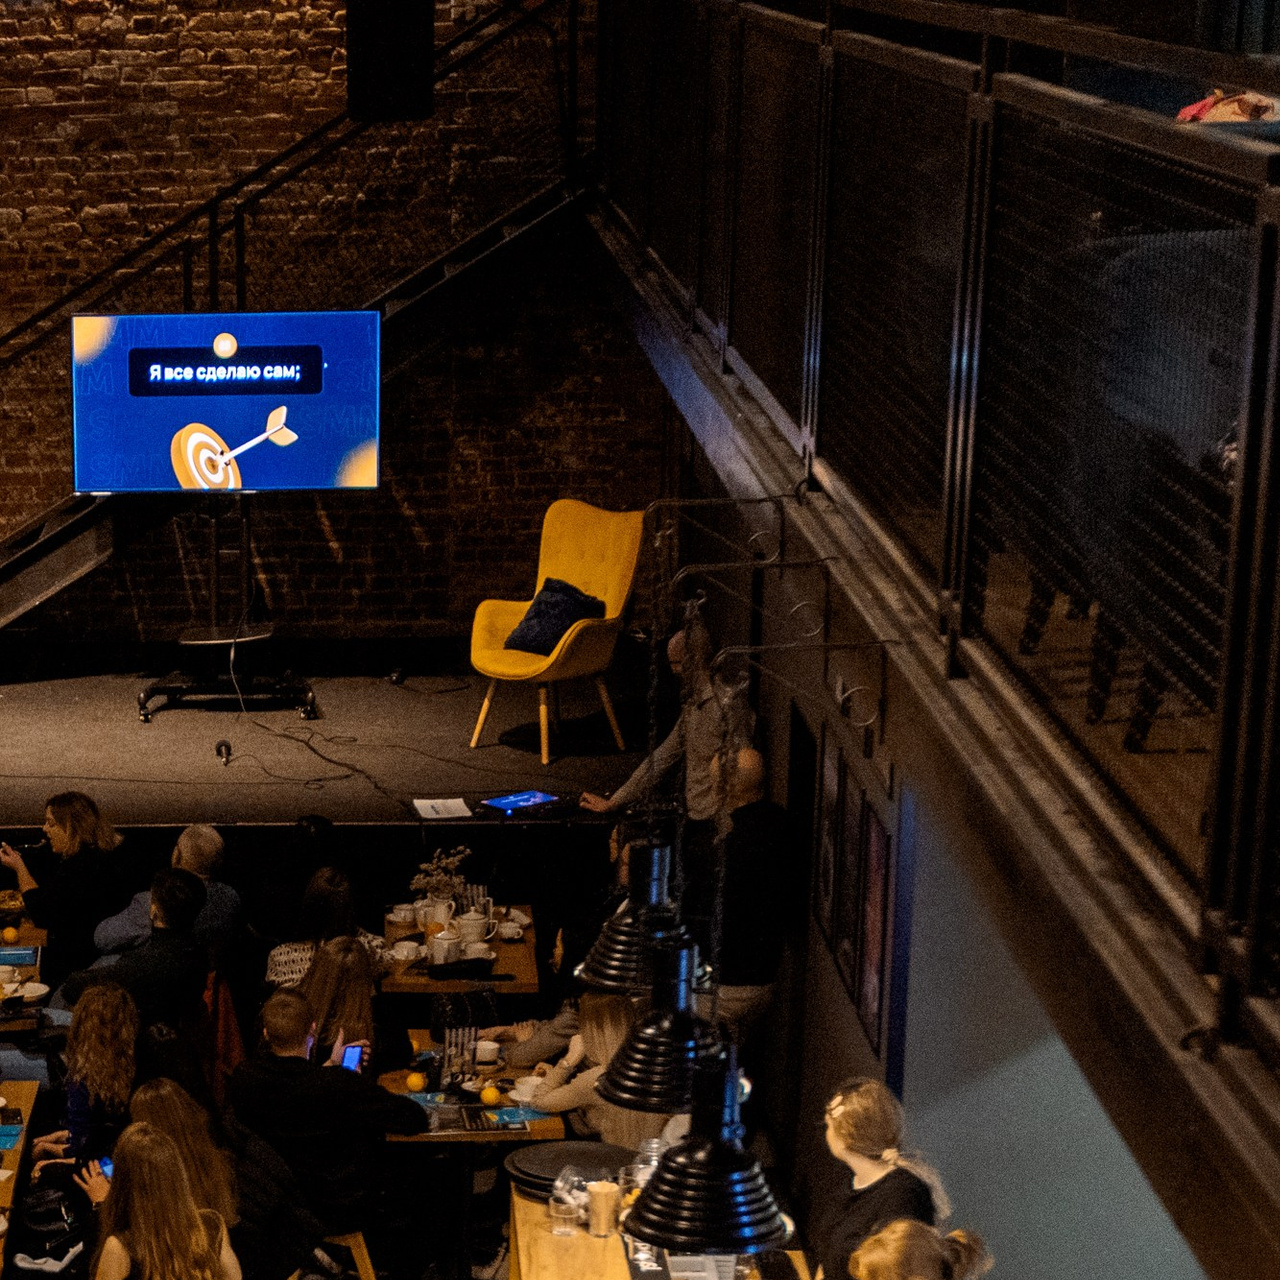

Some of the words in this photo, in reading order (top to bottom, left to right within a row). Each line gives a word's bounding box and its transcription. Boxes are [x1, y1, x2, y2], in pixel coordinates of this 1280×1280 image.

[150, 364, 161, 381] Я
[164, 366, 194, 381] все
[196, 365, 261, 382] сделаю
